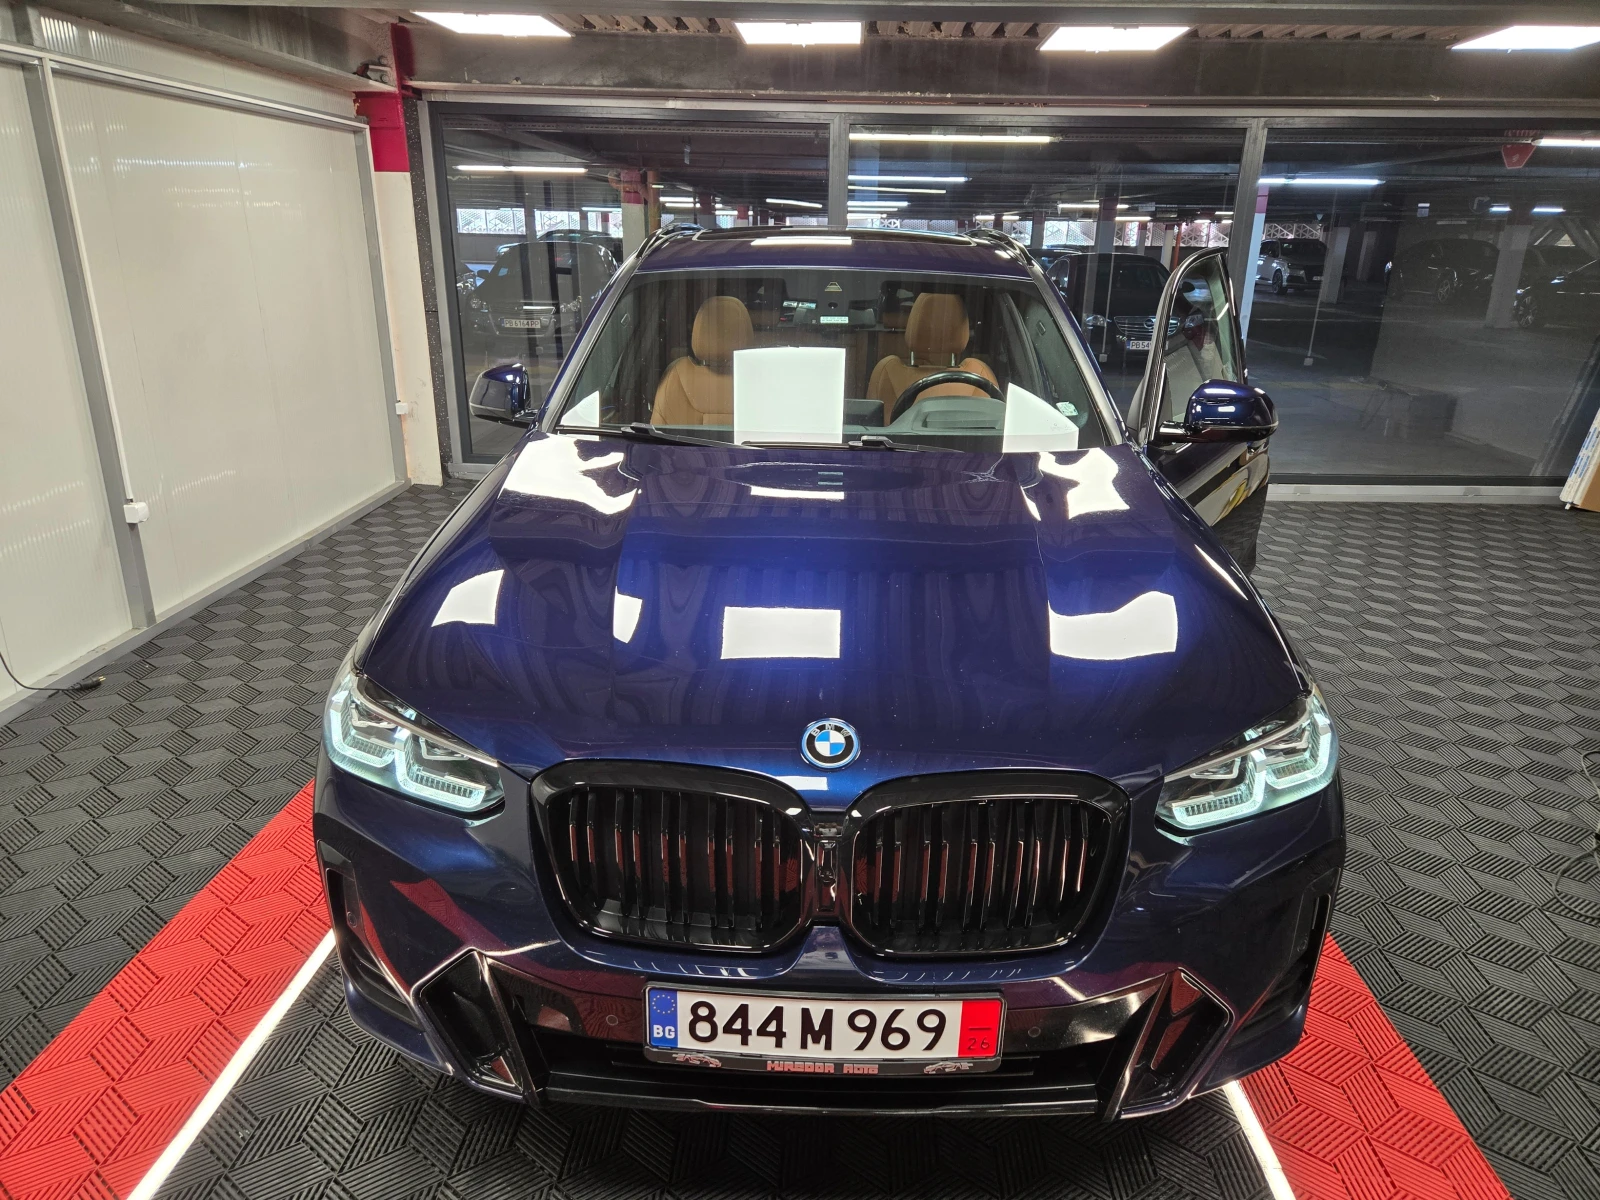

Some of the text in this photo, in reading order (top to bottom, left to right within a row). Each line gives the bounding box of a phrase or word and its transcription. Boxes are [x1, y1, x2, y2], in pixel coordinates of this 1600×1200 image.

[811, 723, 850, 737] BMW
[653, 1000, 947, 1051] BG 844 M 969
[968, 1036, 990, 1051] 26
